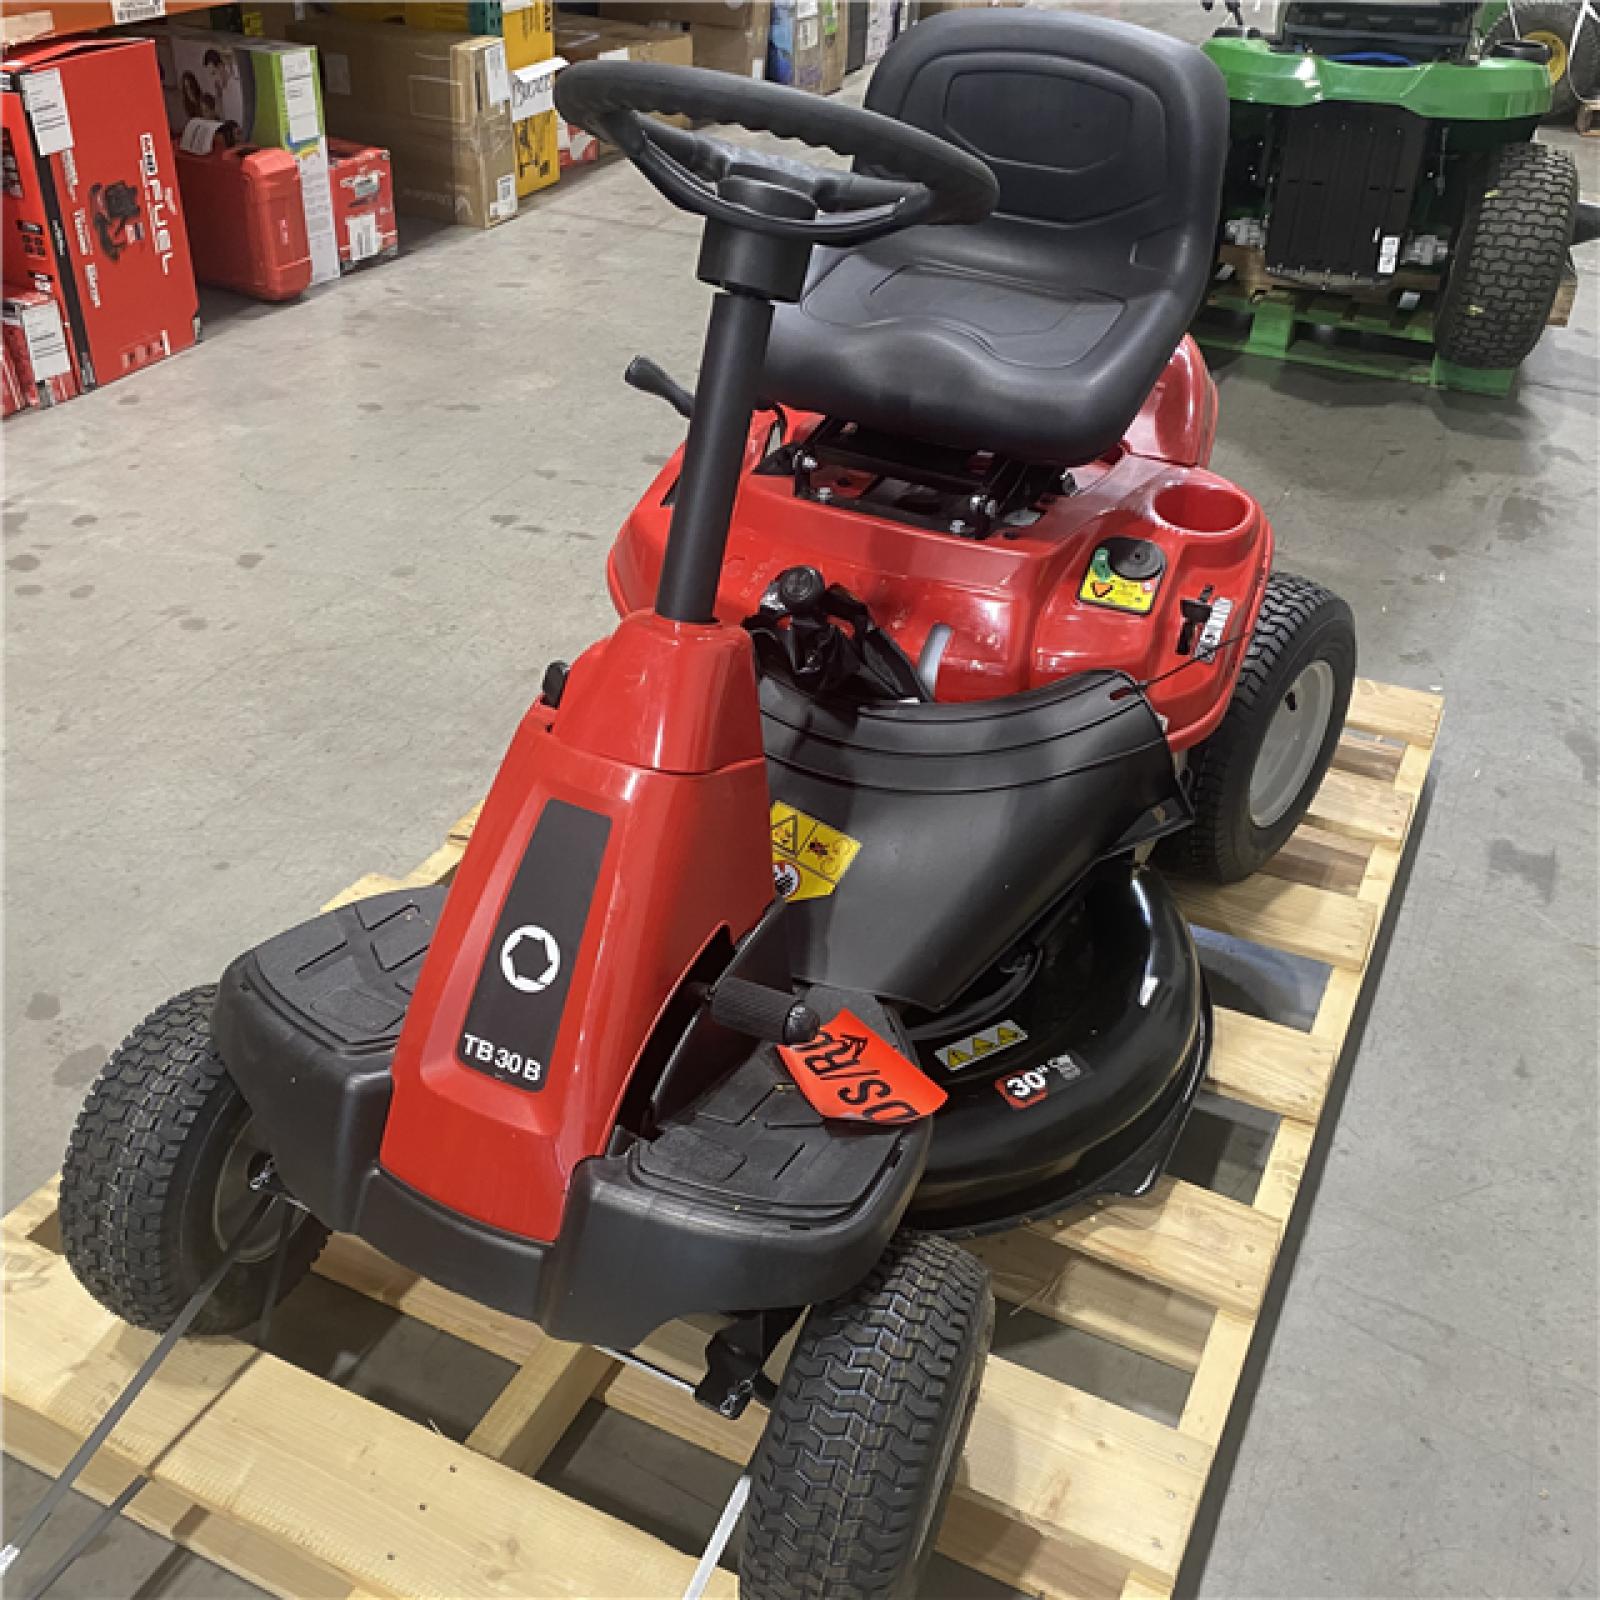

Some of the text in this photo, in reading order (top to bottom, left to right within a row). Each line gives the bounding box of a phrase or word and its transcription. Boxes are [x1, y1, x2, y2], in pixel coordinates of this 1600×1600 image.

[464, 1032, 541, 1082] TB 30 B
